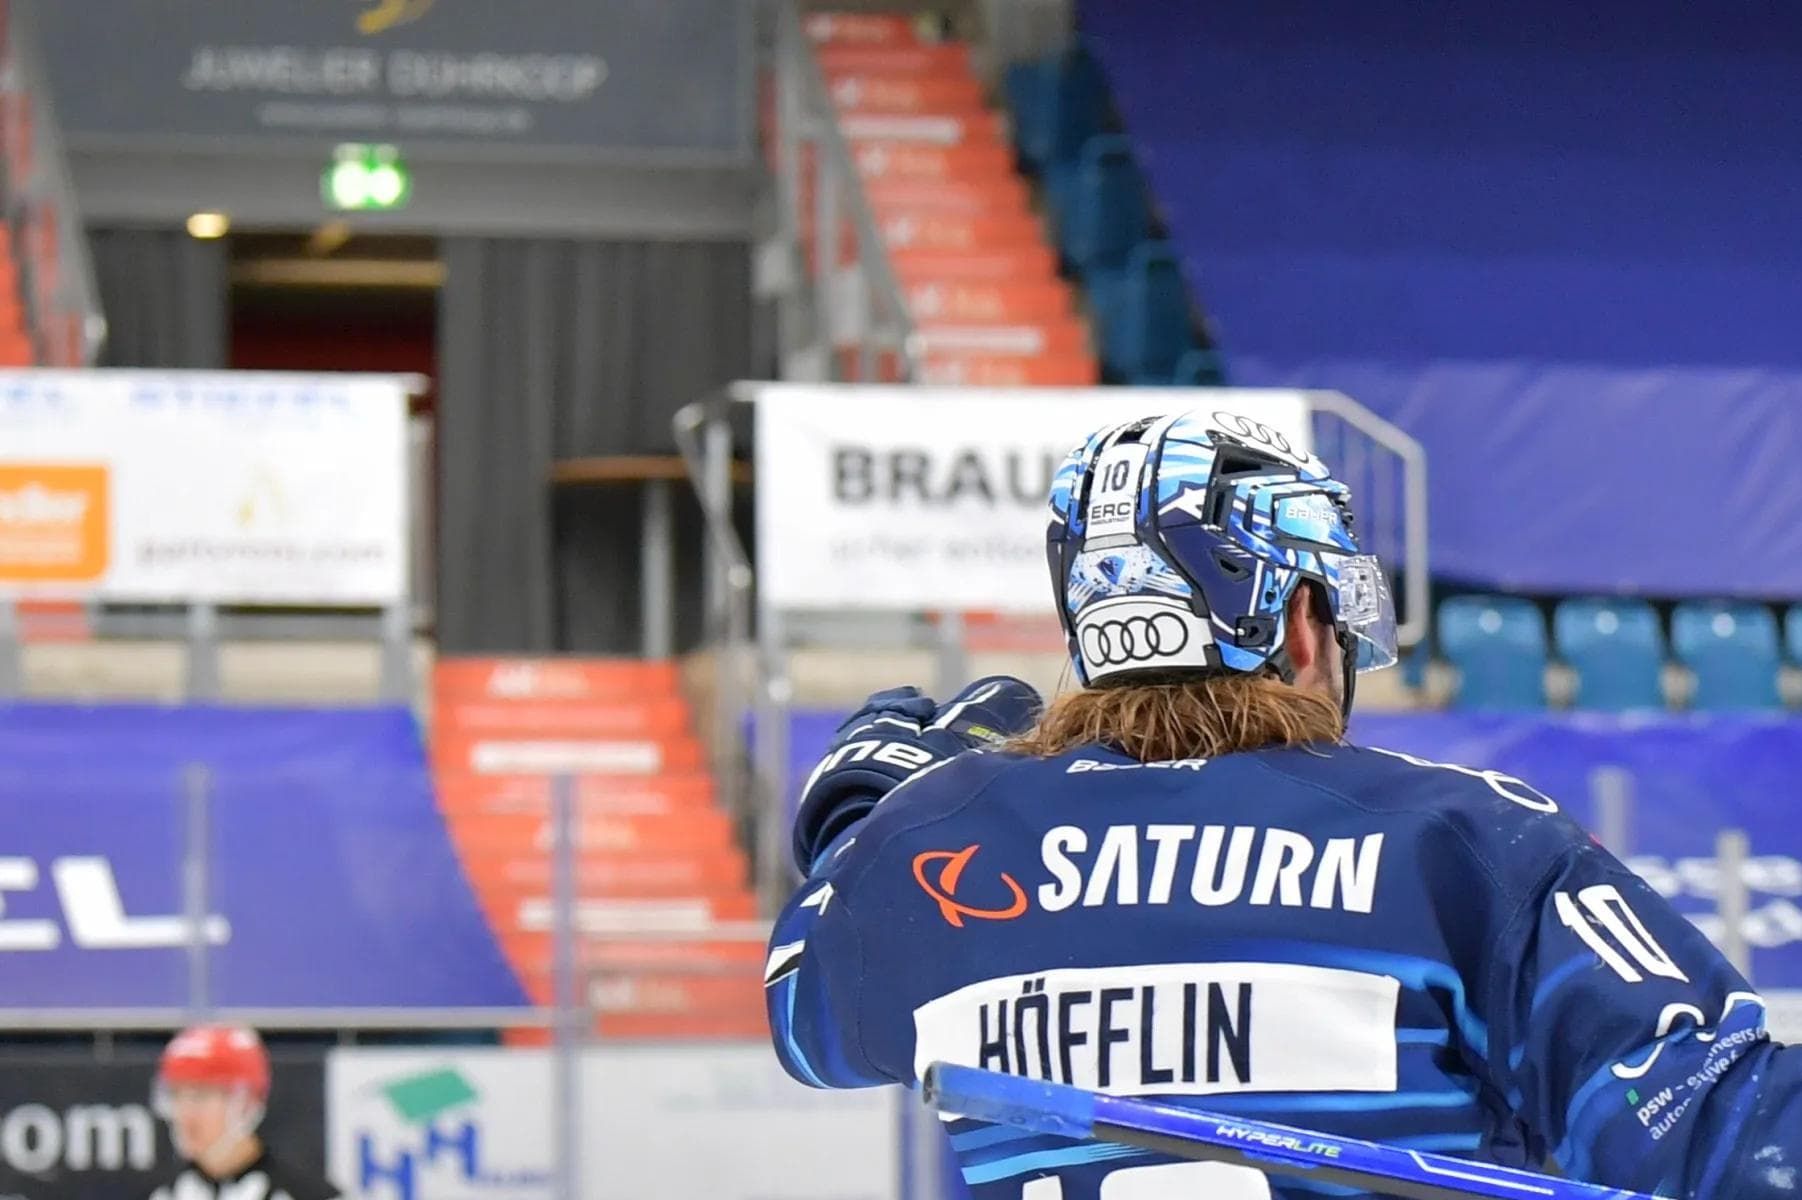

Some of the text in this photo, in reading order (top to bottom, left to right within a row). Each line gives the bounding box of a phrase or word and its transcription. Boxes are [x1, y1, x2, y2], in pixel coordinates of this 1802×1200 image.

[1101, 459, 1129, 493] 10
[1091, 502, 1131, 519] ERC
[1284, 504, 1338, 524] BAUER
[1037, 824, 1384, 914] SATURN
[1554, 885, 1690, 983] 10
[979, 980, 1253, 1087] HÖFFLIN
[1637, 1087, 1674, 1126] psw
[1216, 1125, 1343, 1159] HYPERLITE
